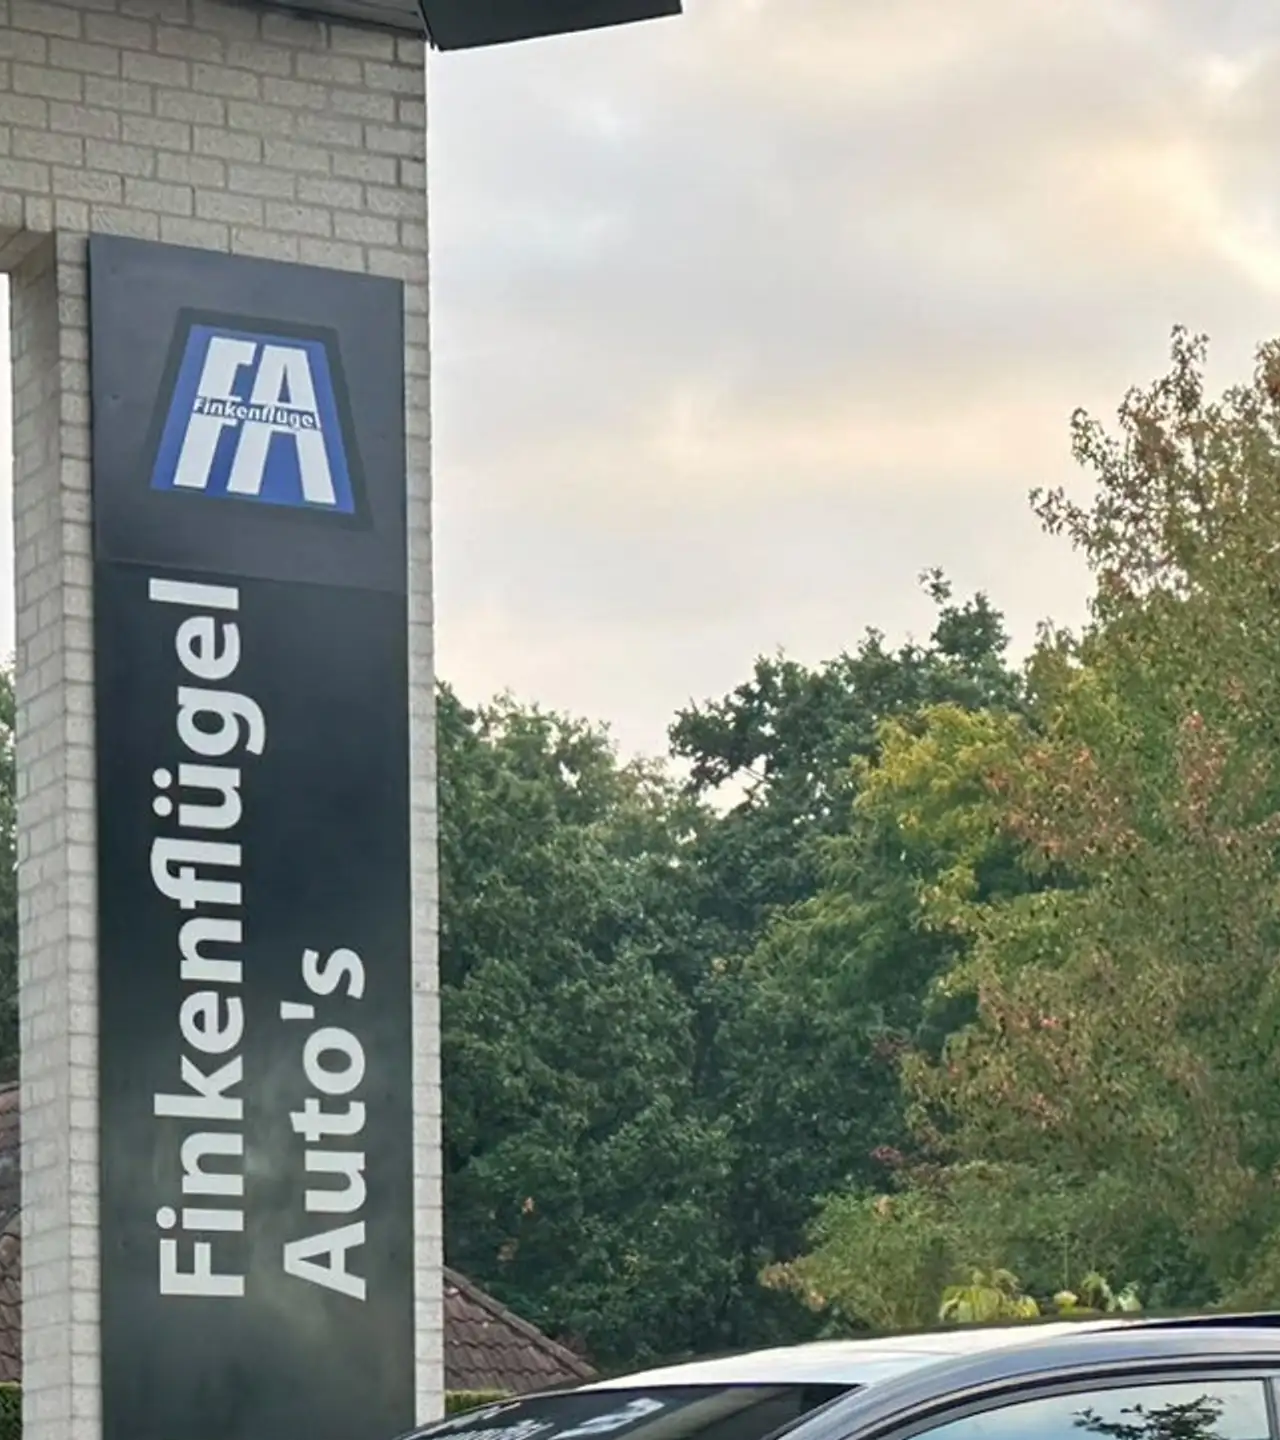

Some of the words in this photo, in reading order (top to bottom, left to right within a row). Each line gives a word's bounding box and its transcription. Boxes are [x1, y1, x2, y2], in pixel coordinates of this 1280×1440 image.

[193, 396, 322, 433] Finkenflügel
[149, 577, 266, 1297] Finkenflügel
[282, 947, 367, 1301] Auto's
